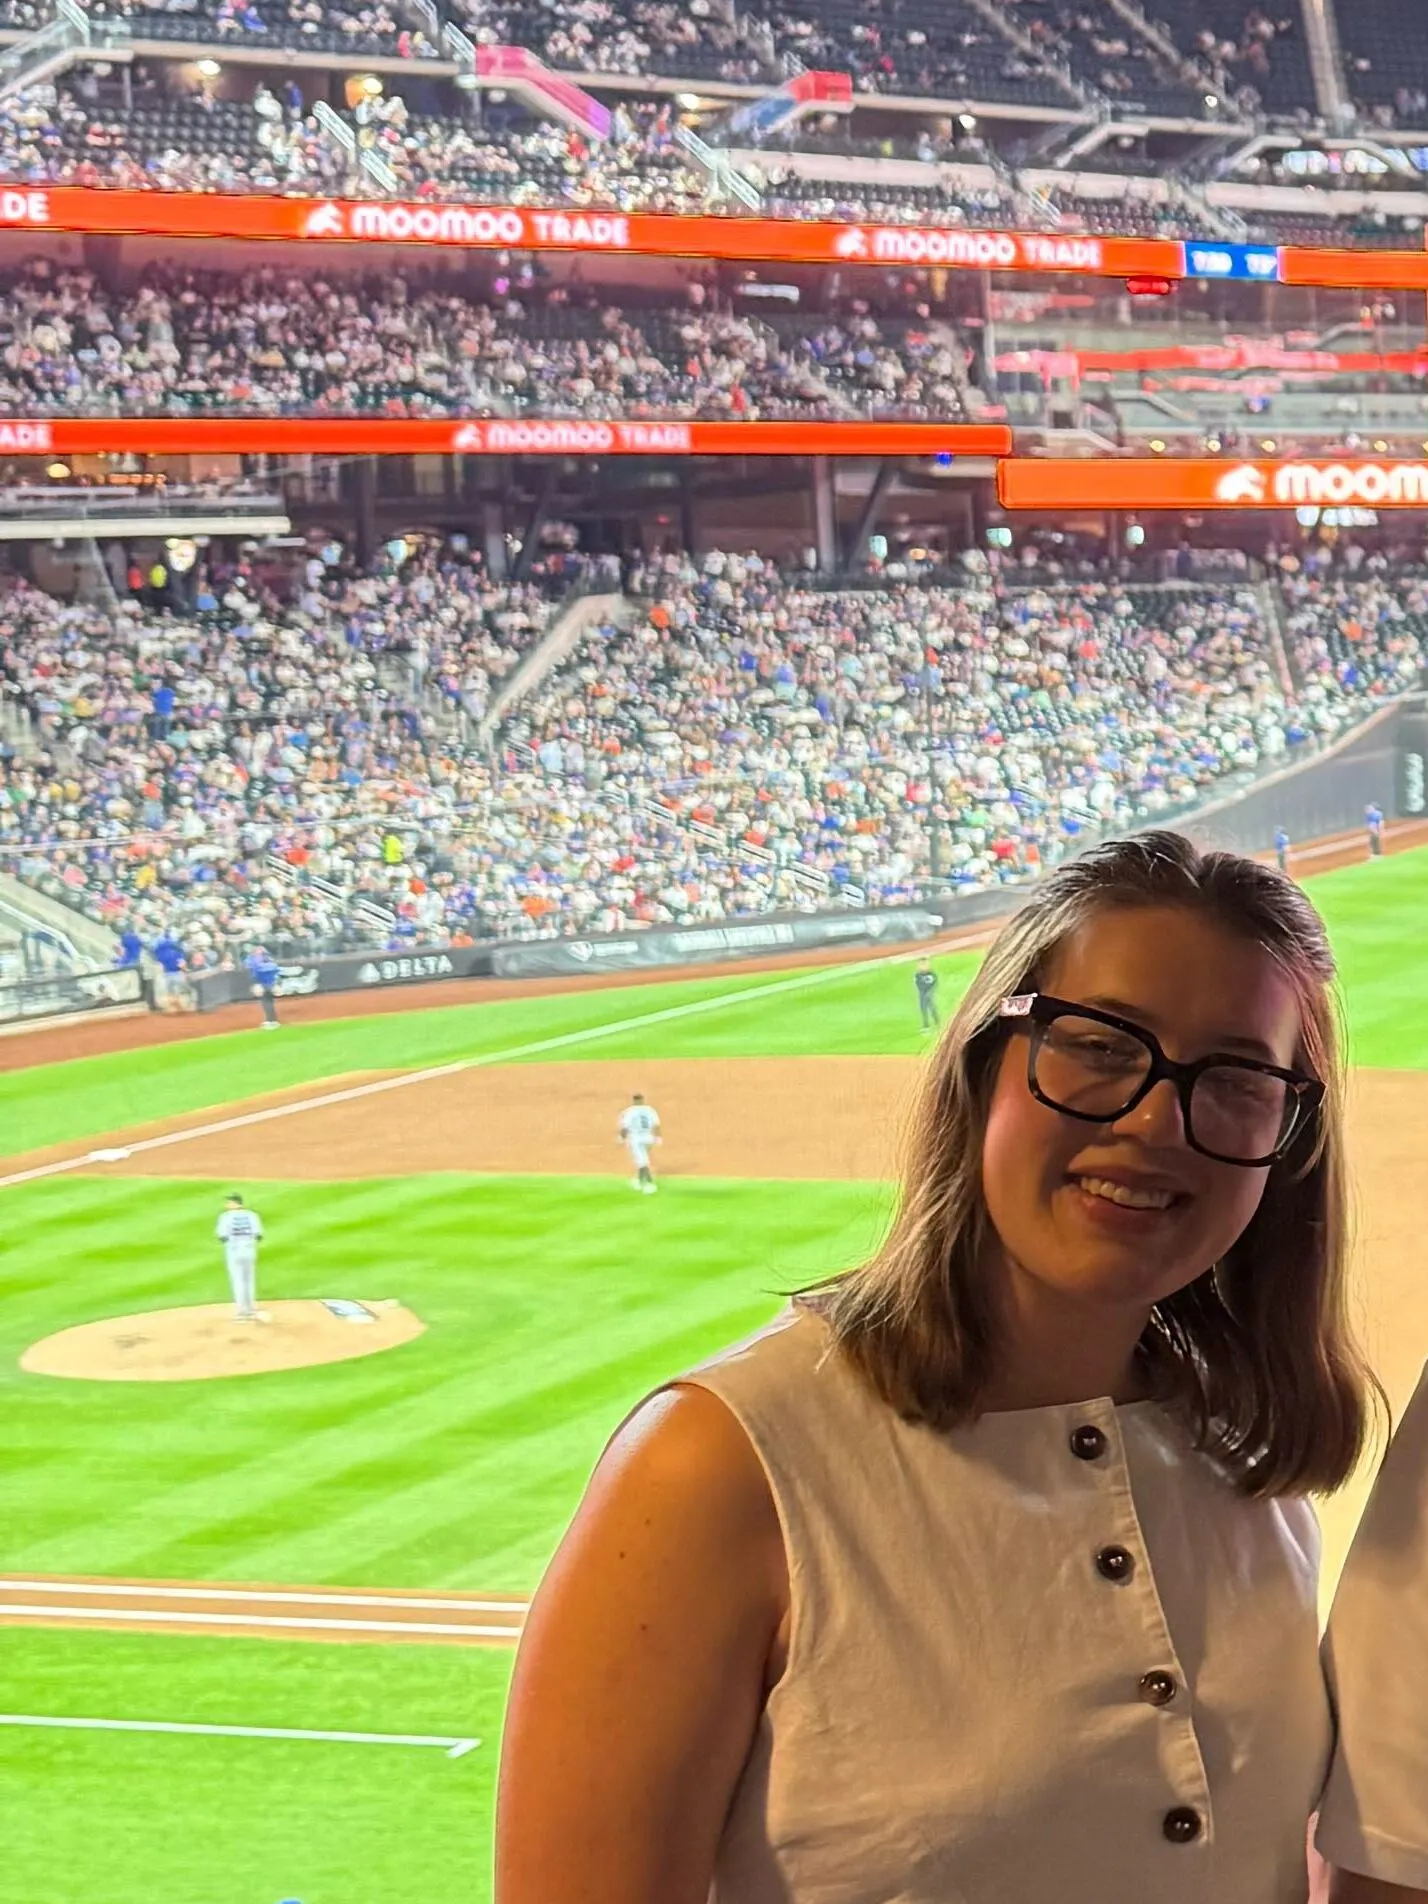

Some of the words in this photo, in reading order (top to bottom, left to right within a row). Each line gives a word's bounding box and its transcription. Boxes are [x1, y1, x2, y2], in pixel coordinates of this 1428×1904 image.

[533, 214, 629, 247] TRADE
[1022, 238, 1101, 269] TRADE
[618, 424, 691, 450] TRADE
[380, 954, 454, 980] DELTA
